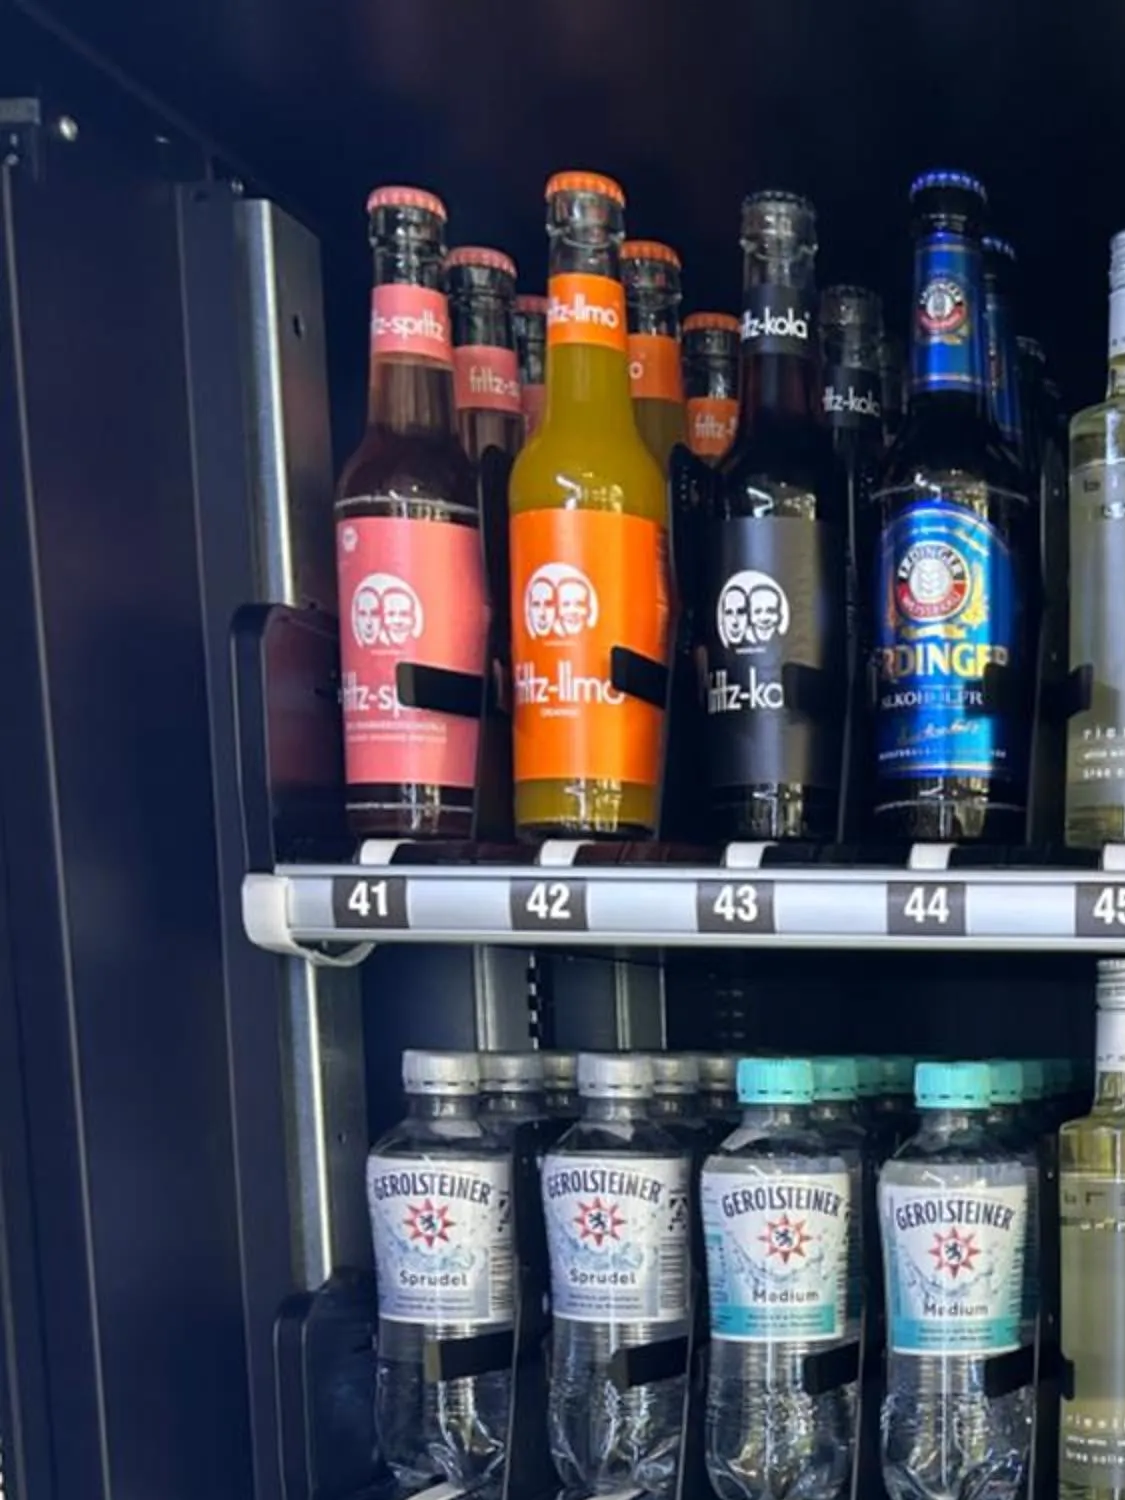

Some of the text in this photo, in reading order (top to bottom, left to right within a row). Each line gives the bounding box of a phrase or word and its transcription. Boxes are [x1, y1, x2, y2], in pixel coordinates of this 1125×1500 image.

[348, 880, 388, 917] 41
[526, 883, 571, 919] 42
[713, 885, 758, 922] 43
[903, 885, 951, 924] 44
[374, 1171, 493, 1205] GEROLSTEINER
[547, 1169, 663, 1203] GEROLSTEINER
[722, 1185, 843, 1219] GEROLSTEINER
[896, 1199, 1014, 1231] GEROLSTEINER
[400, 1270, 468, 1288] Sprudel
[569, 1268, 637, 1287] Sprudel
[751, 1287, 820, 1303] Medium
[922, 1301, 989, 1317] Medium
